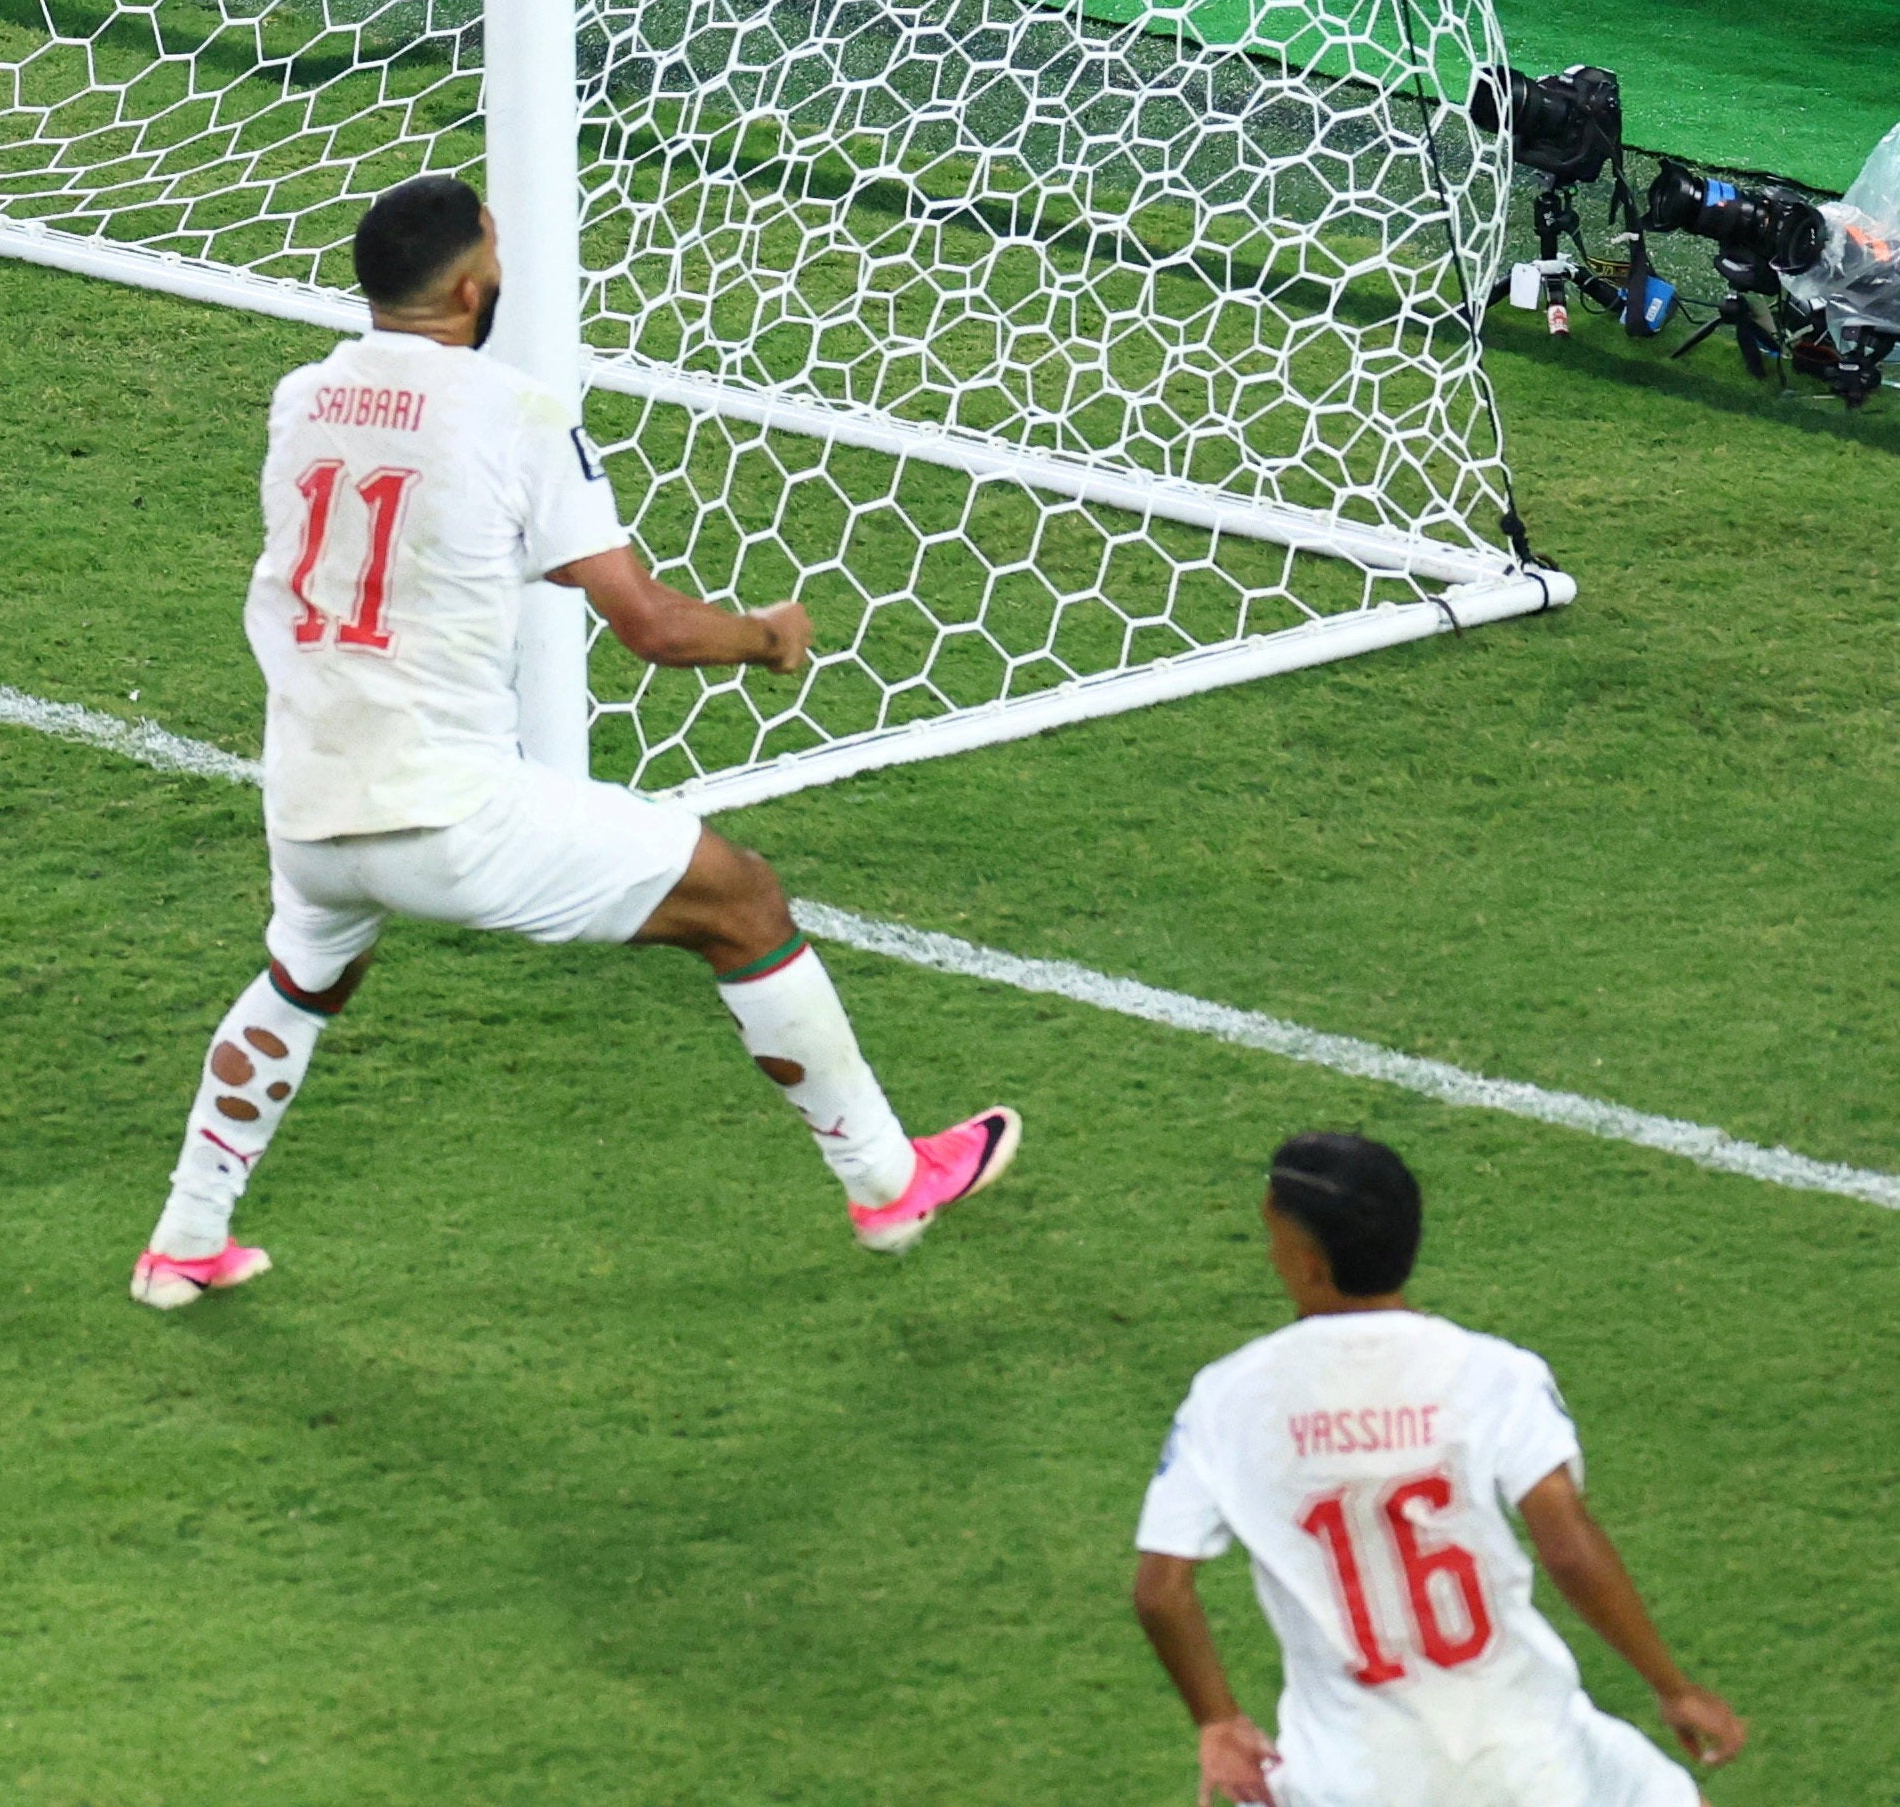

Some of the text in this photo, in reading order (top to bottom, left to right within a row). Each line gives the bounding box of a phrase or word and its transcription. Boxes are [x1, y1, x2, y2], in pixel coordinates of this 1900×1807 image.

[308, 386, 427, 433] SAIBARI
[290, 458, 422, 660] 11
[1287, 1404, 1439, 1458] YASSINE
[1295, 1463, 1495, 1687] 16
